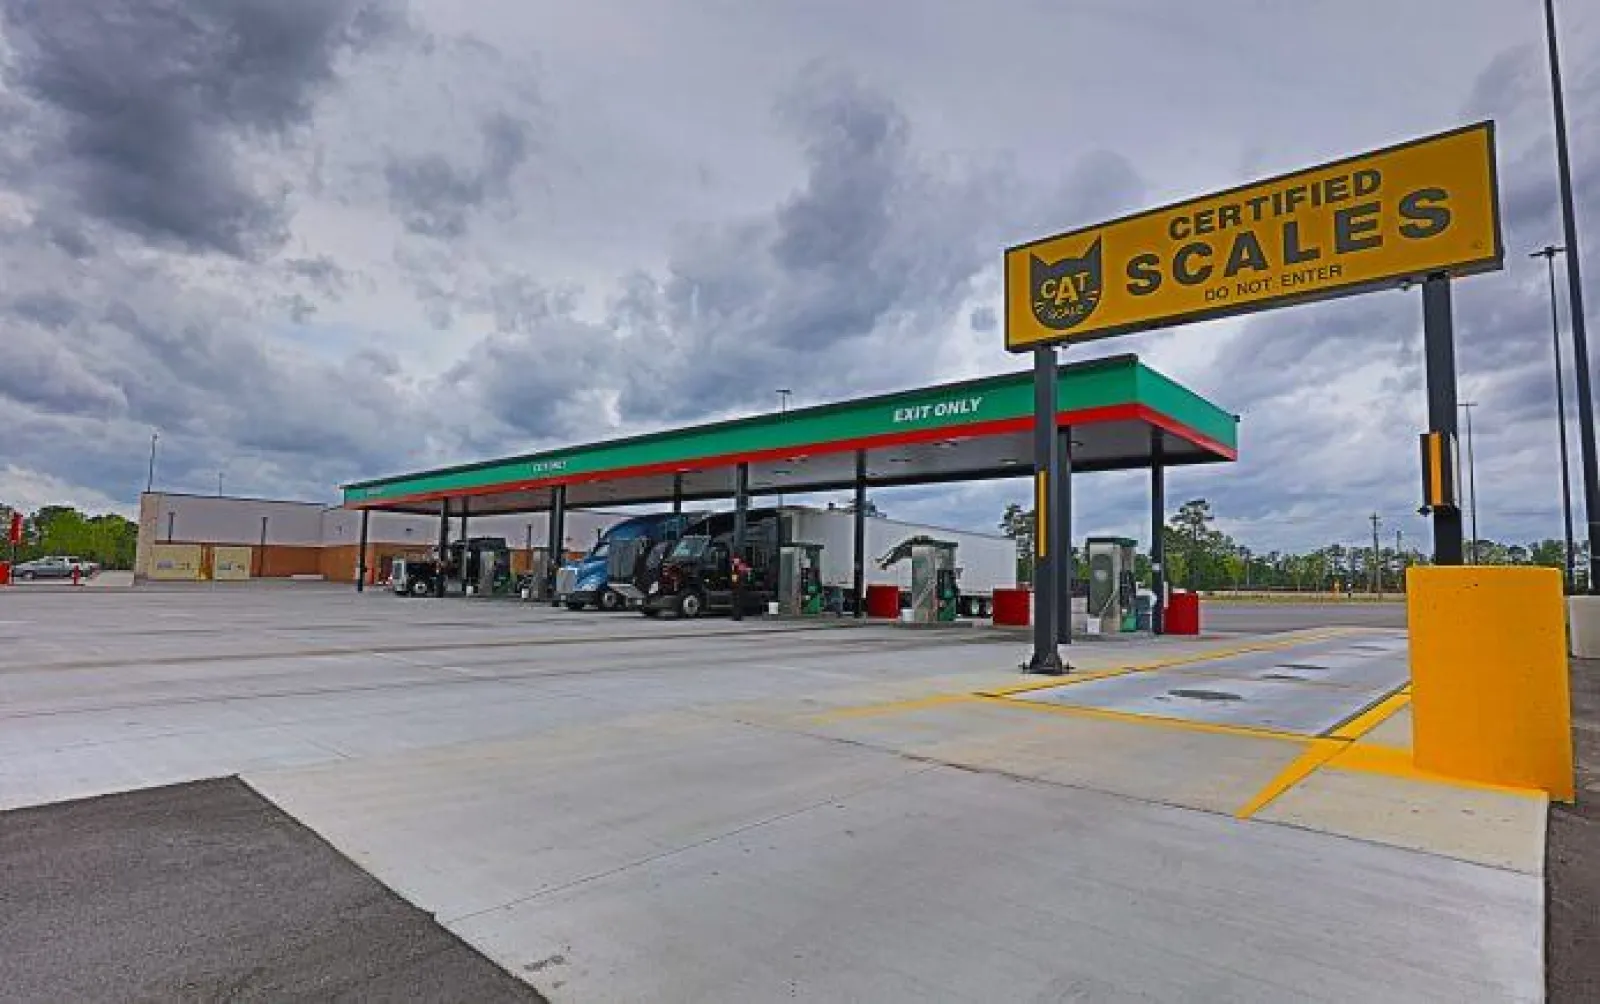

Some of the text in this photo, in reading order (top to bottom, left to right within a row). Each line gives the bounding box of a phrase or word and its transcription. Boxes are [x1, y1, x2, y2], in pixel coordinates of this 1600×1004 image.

[1168, 169, 1383, 240] CERTIFIED
[1126, 187, 1452, 296] SCALES
[1040, 271, 1091, 306] CAT
[1204, 265, 1342, 301] DO NOT ENTER
[893, 396, 983, 422] EXIT ONLY
